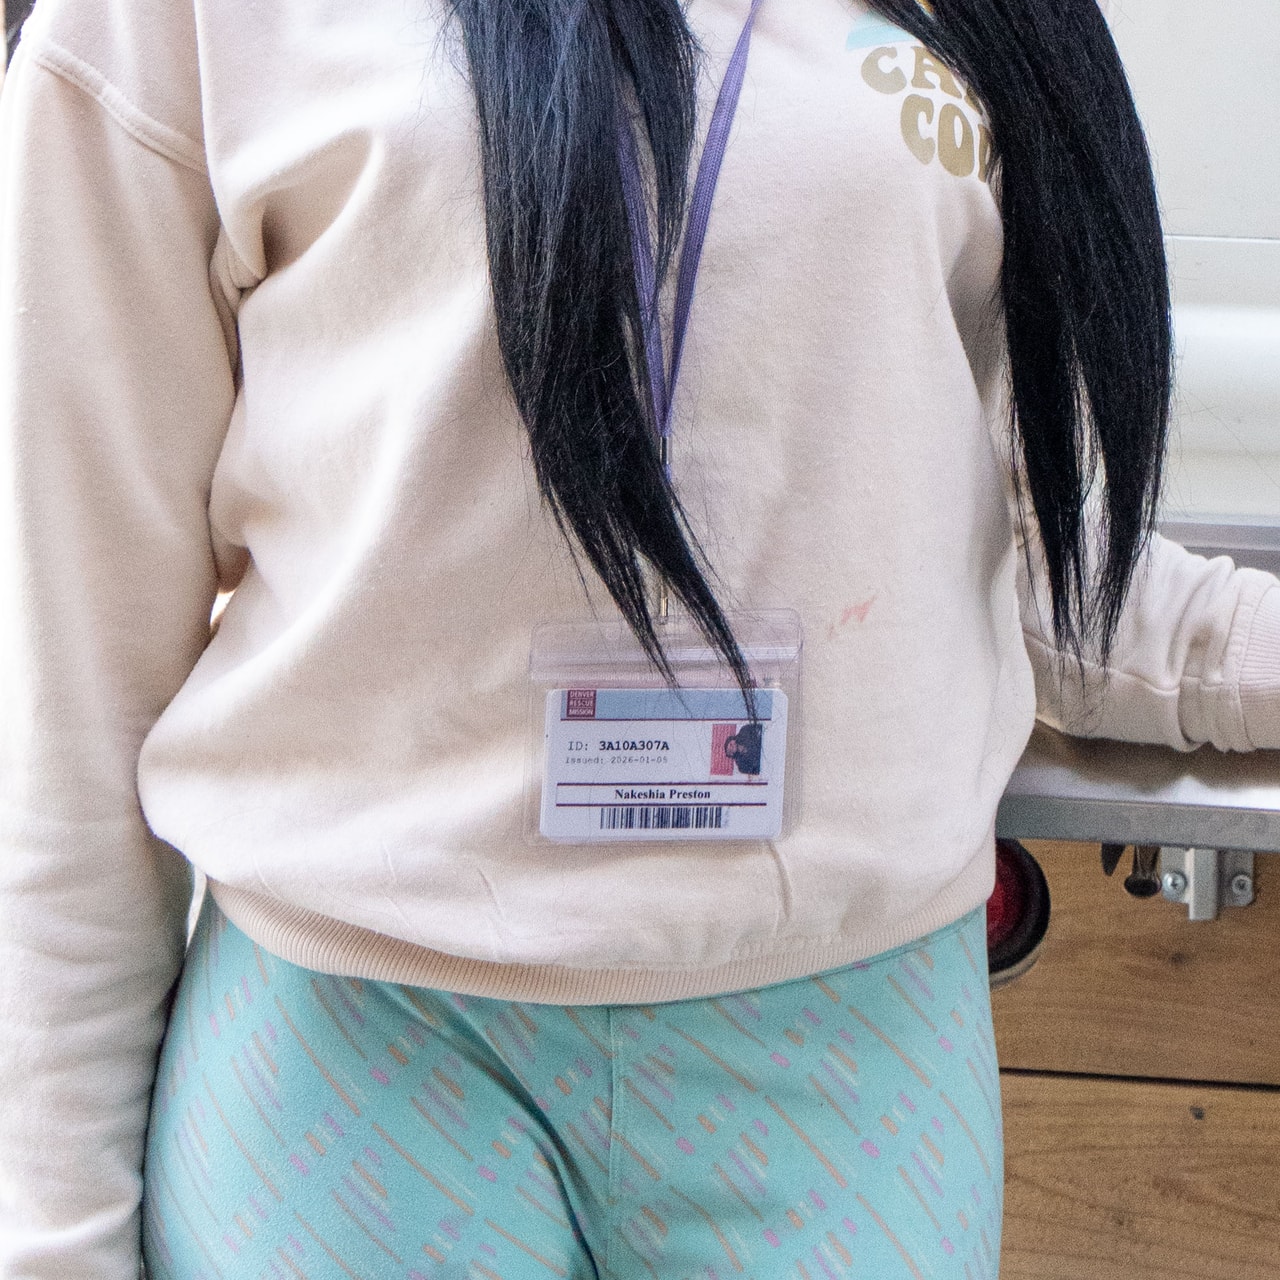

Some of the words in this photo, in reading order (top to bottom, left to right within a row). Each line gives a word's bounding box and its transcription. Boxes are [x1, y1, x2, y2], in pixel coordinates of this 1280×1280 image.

[568, 741, 588, 751] ID:
[599, 740, 670, 751] 3A10A307A
[565, 756, 604, 765] Issued:
[615, 789, 665, 799] Nakeshia
[669, 789, 711, 799] Preston
